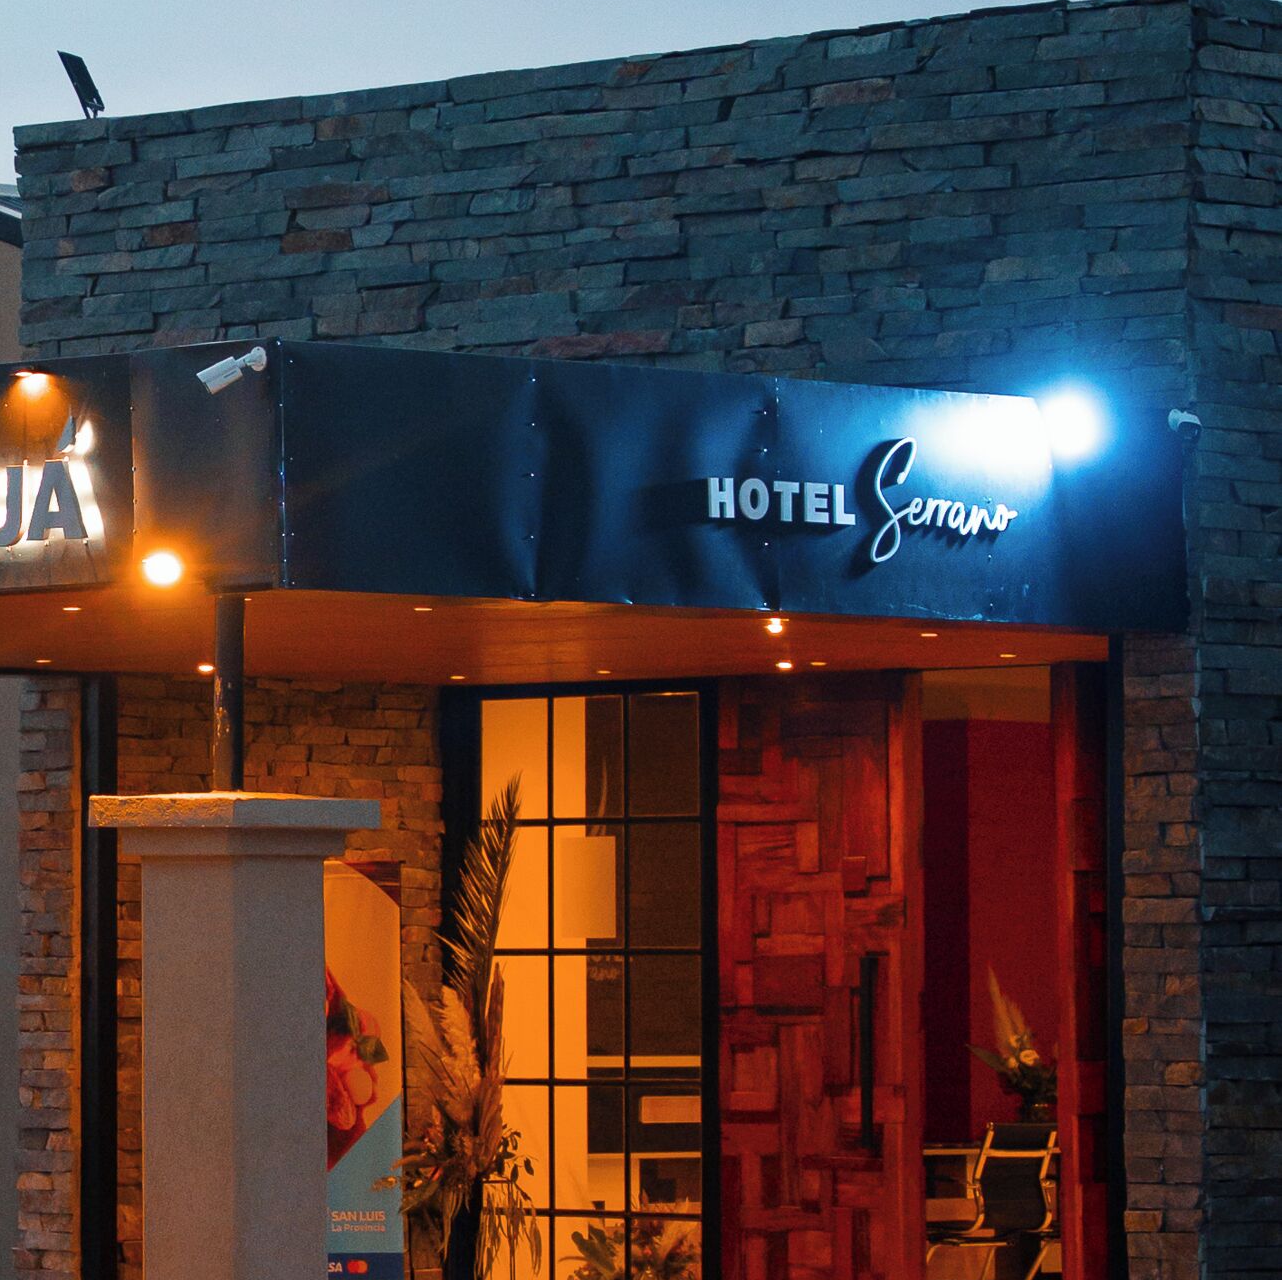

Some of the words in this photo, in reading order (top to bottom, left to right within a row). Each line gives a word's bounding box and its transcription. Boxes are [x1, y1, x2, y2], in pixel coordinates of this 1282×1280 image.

[707, 477, 856, 526] HOTEL
[871, 436, 1018, 563] Serrano
[331, 1210, 357, 1221] SAN
[359, 1210, 386, 1221] LUIS
